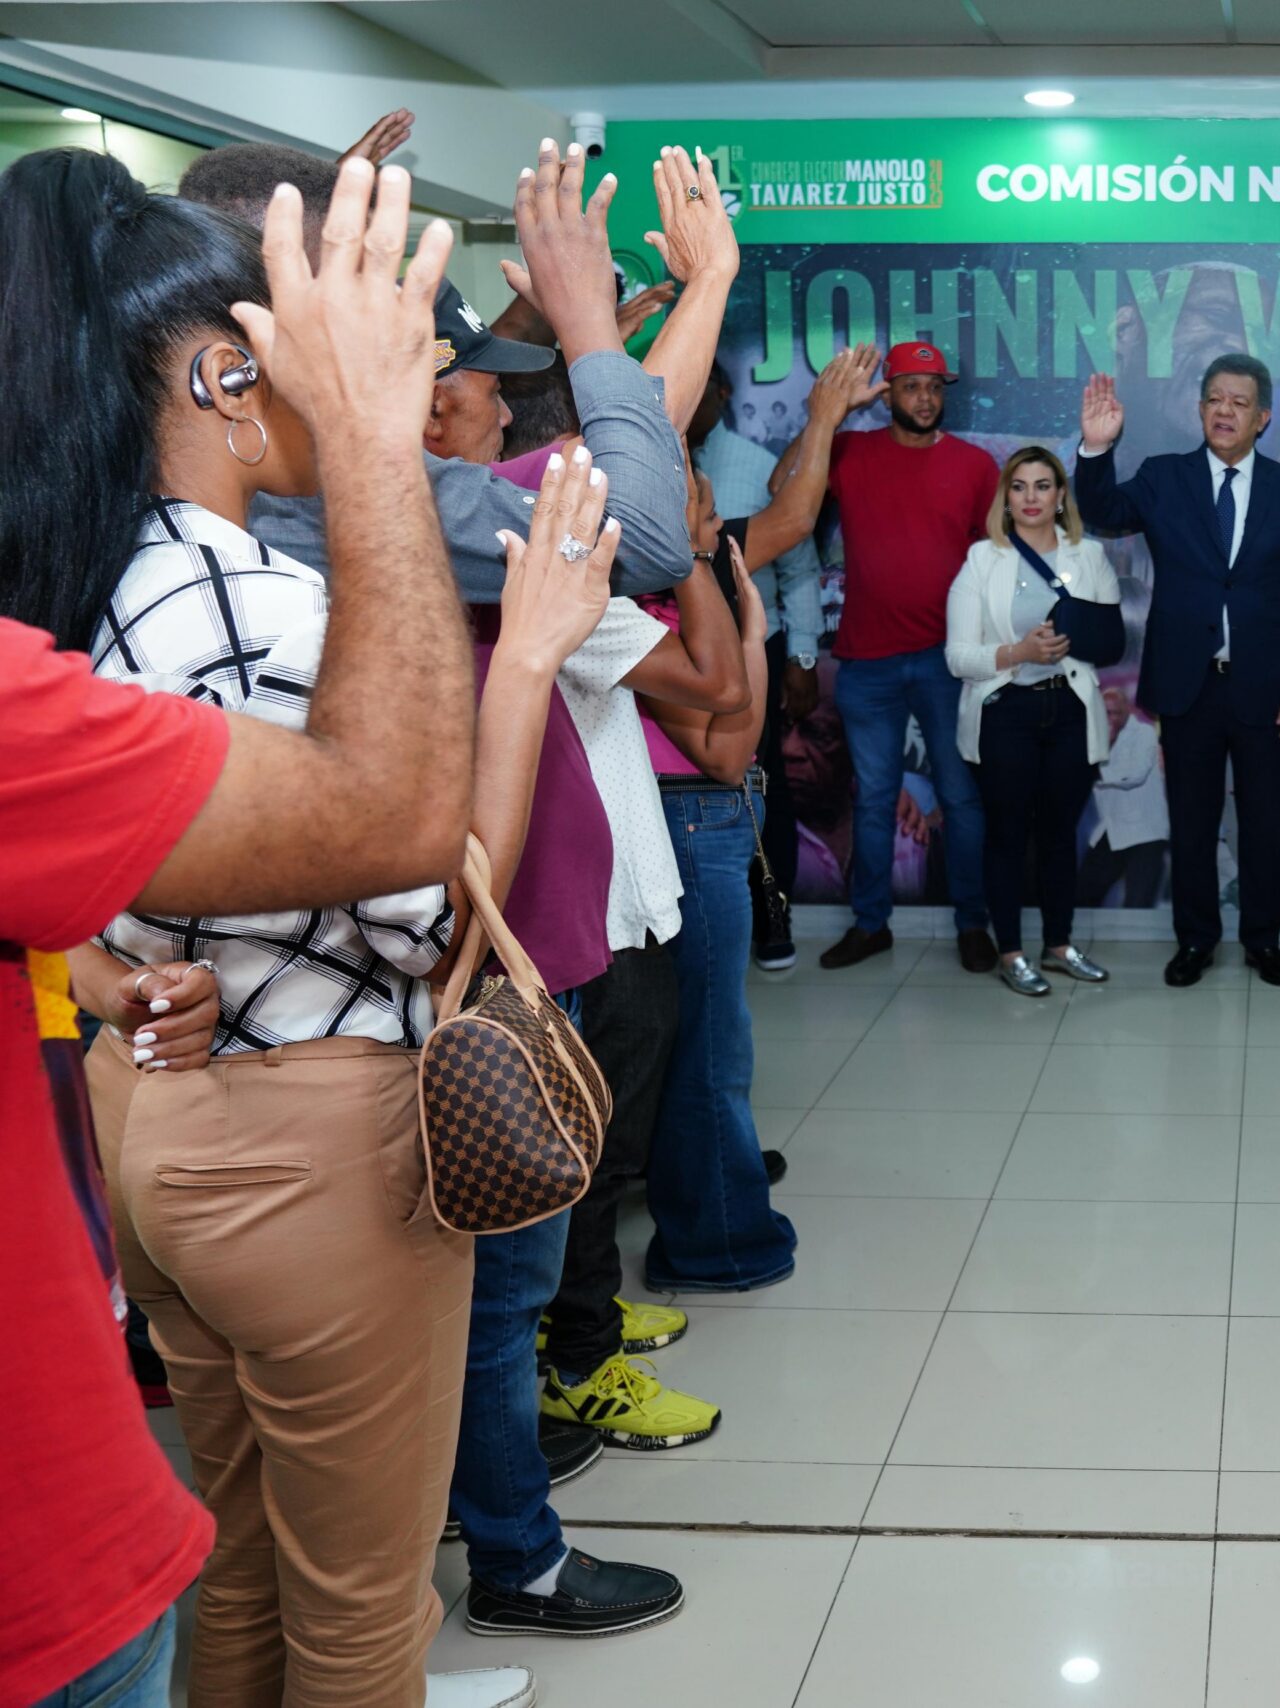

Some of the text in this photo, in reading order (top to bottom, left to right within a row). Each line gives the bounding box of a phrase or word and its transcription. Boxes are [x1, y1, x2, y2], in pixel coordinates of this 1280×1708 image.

[845, 159, 925, 182] MANOLO
[976, 154, 1235, 203] COMISIÓN
[750, 182, 926, 206] TAVAREZ JUSTO
[751, 269, 1194, 383] JOHNNY
